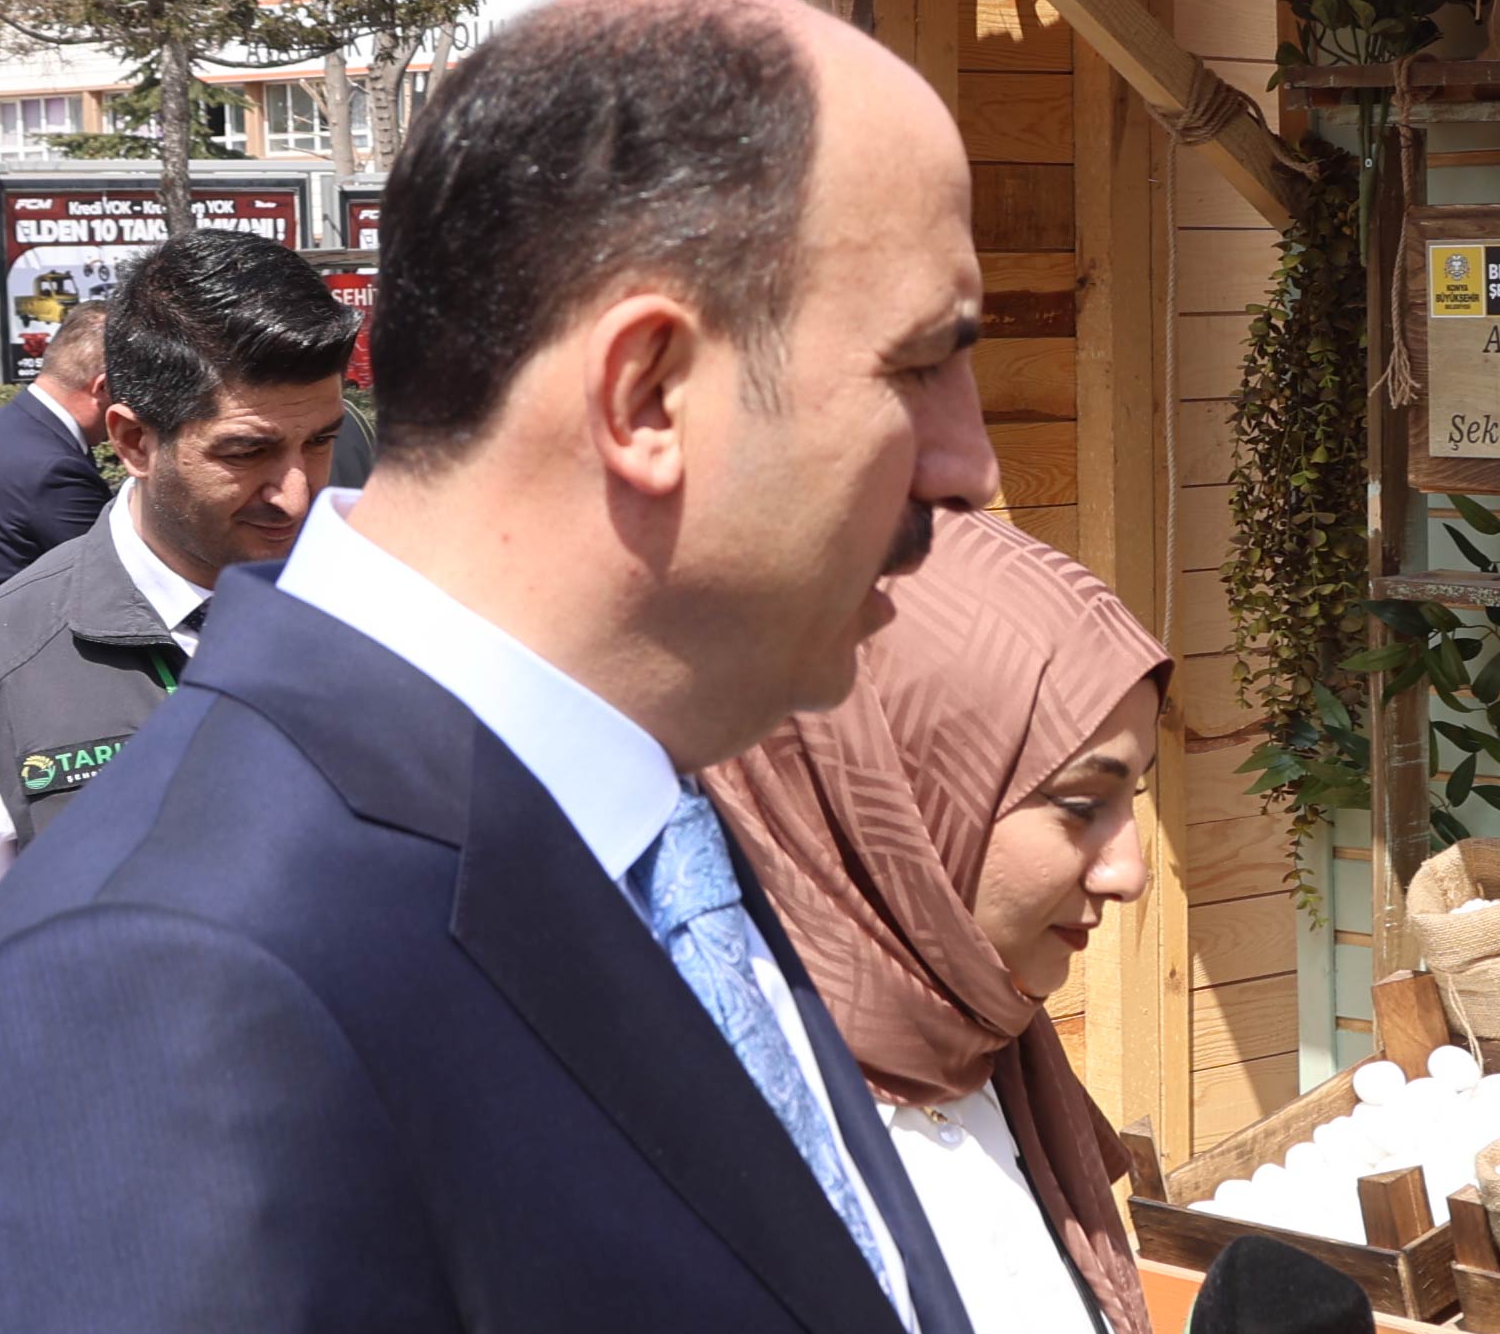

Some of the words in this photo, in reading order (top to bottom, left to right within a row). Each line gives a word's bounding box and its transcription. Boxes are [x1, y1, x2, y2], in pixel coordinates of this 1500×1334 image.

[205, 200, 235, 214] YOK
[15, 219, 89, 242] ELDEN
[90, 219, 117, 242] 10
[118, 219, 168, 242] TAK
